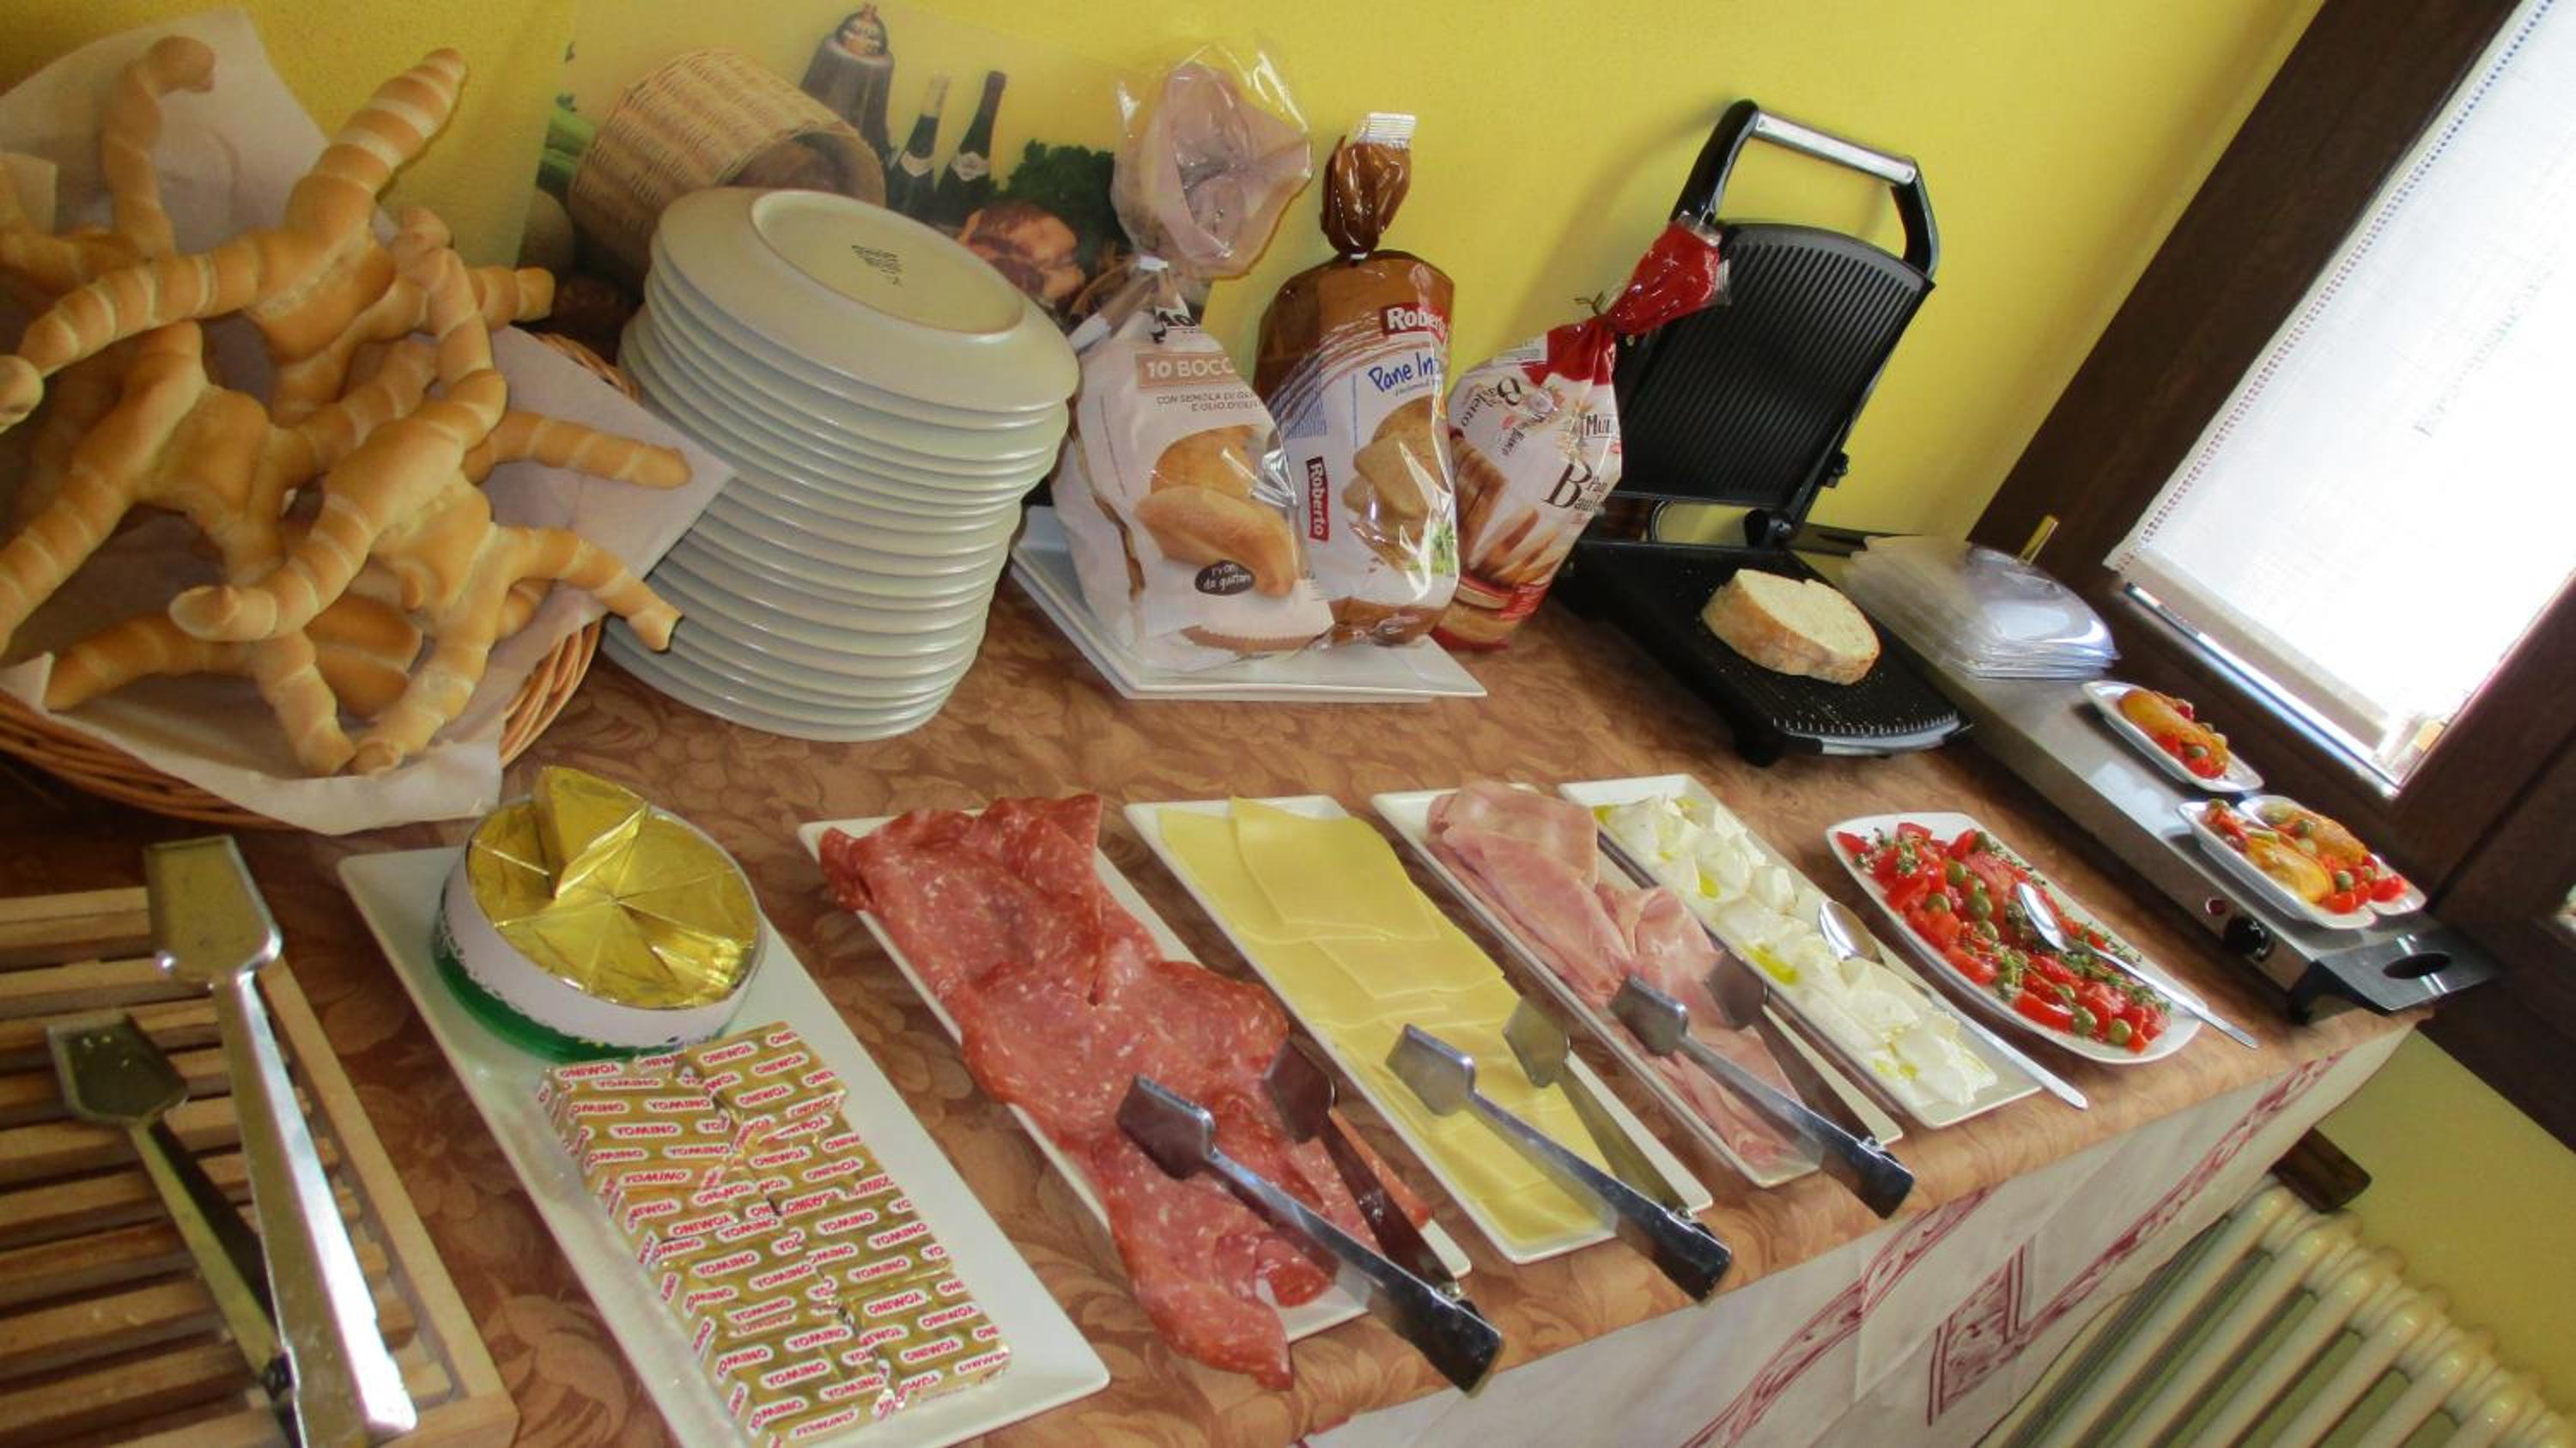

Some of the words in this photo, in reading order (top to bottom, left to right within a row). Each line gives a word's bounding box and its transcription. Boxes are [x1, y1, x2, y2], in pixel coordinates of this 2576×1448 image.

[1146, 360, 1171, 378] 10
[1368, 364, 1413, 392] Pane
[1310, 464, 1325, 536] Roberto
